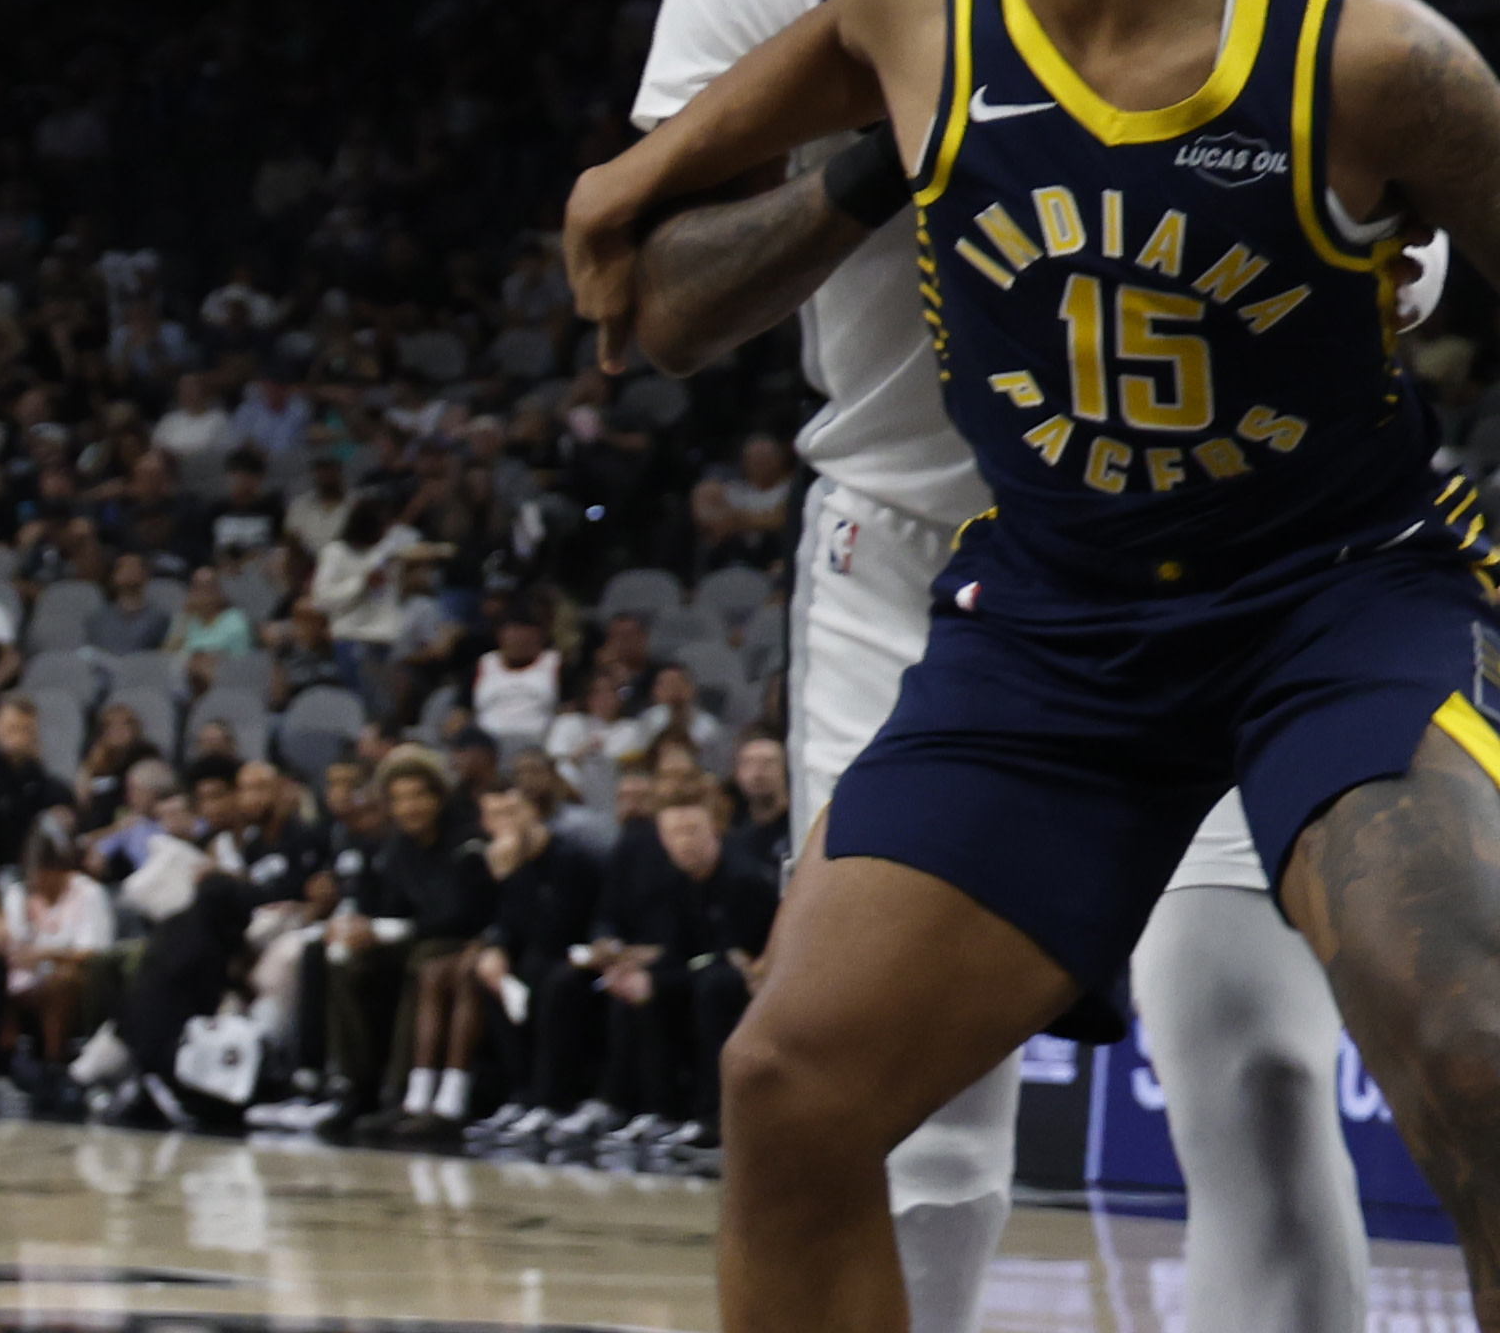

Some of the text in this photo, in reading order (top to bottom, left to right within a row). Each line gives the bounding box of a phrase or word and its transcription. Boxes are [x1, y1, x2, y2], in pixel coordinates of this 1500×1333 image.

[1174, 145, 1289, 173] LUCAS OIL
[954, 185, 1311, 334] INDIANA
[1059, 273, 1215, 432] 15
[988, 370, 1308, 493] PACERS
